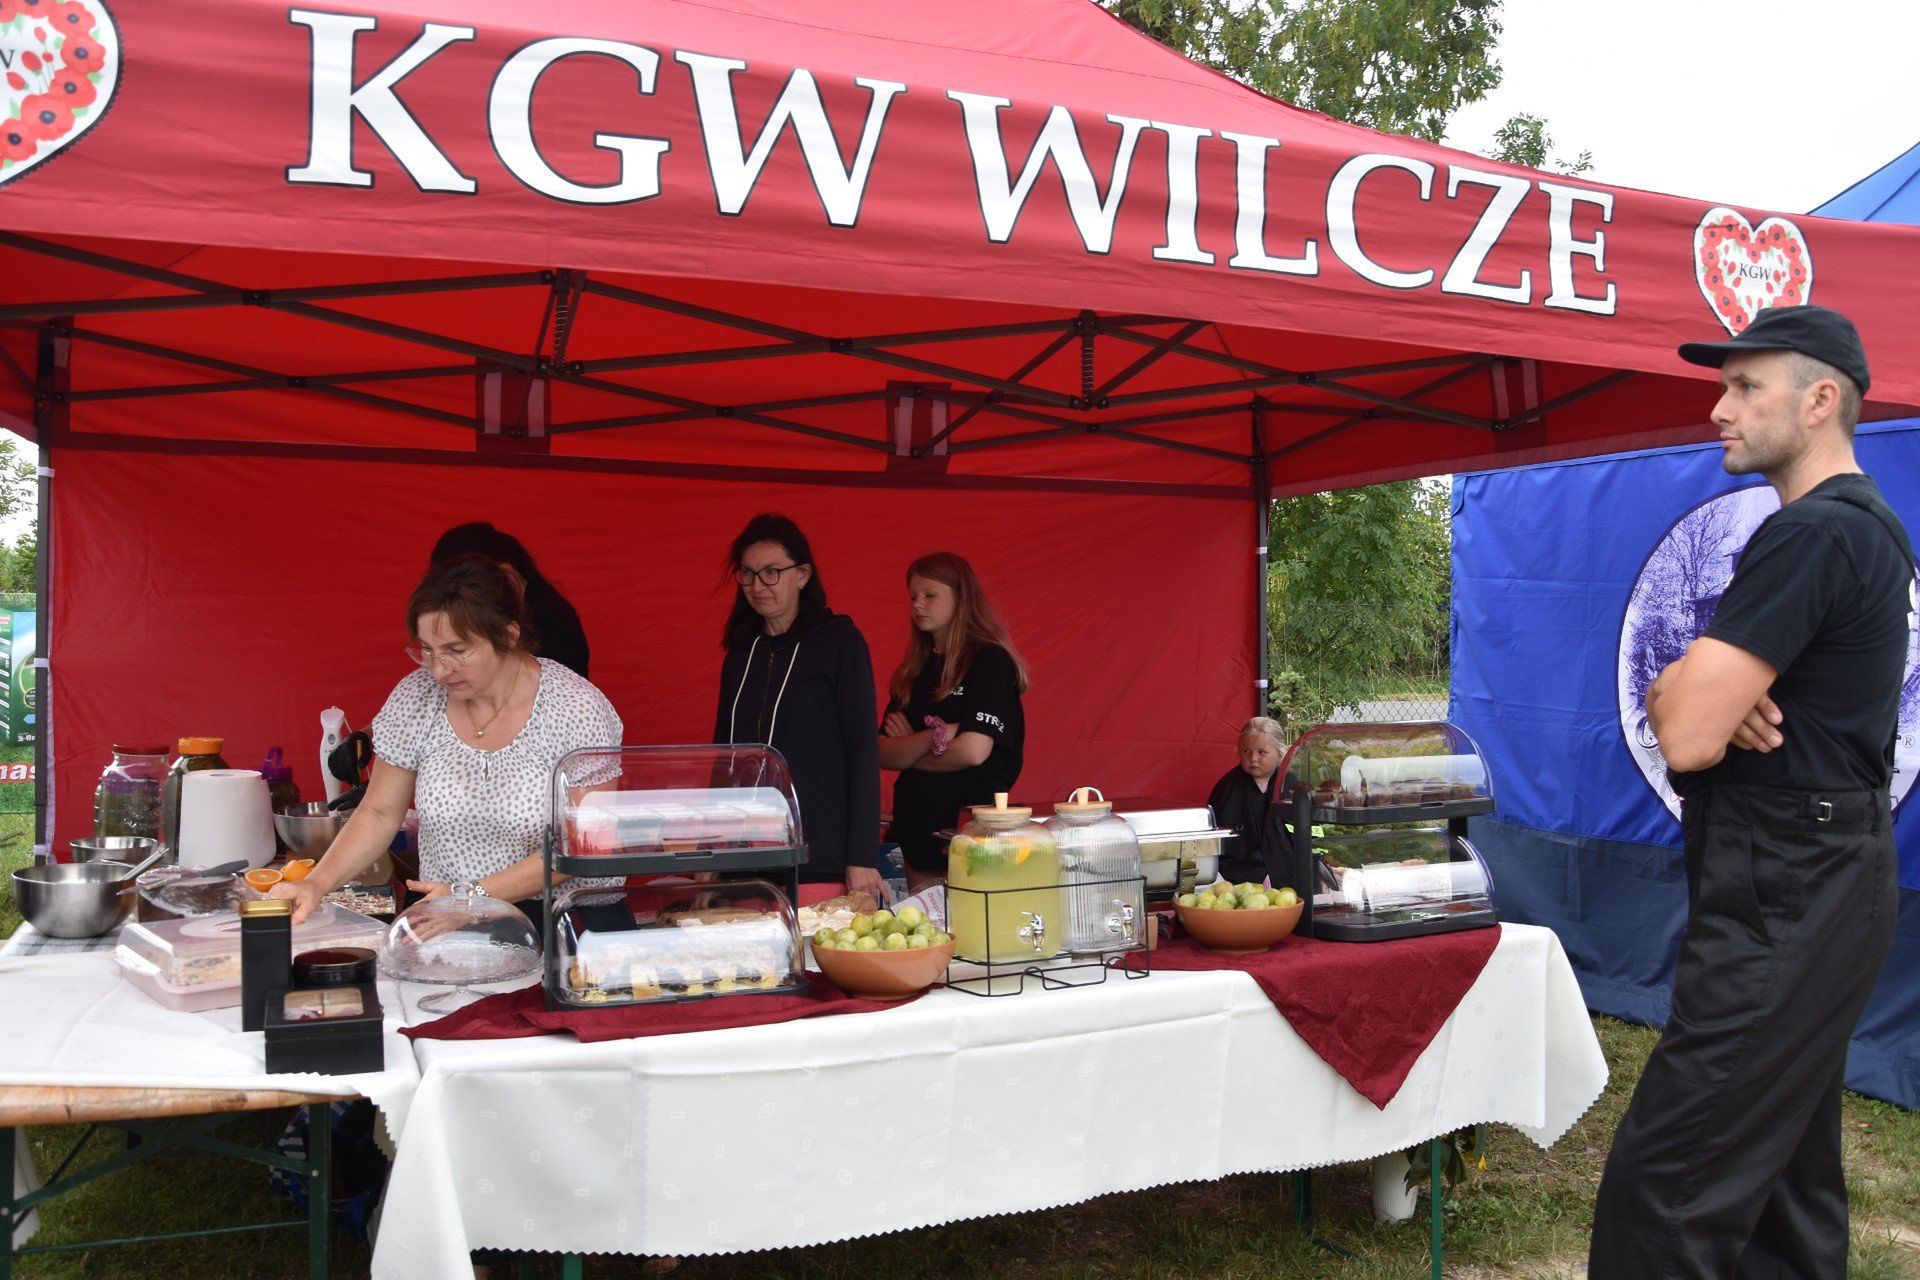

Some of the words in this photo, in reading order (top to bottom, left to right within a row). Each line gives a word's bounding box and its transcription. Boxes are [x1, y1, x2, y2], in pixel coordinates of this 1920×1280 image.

[287, 9, 907, 227] KGW
[945, 89, 1618, 317] WILCZE
[1739, 262, 1772, 281] KGW
